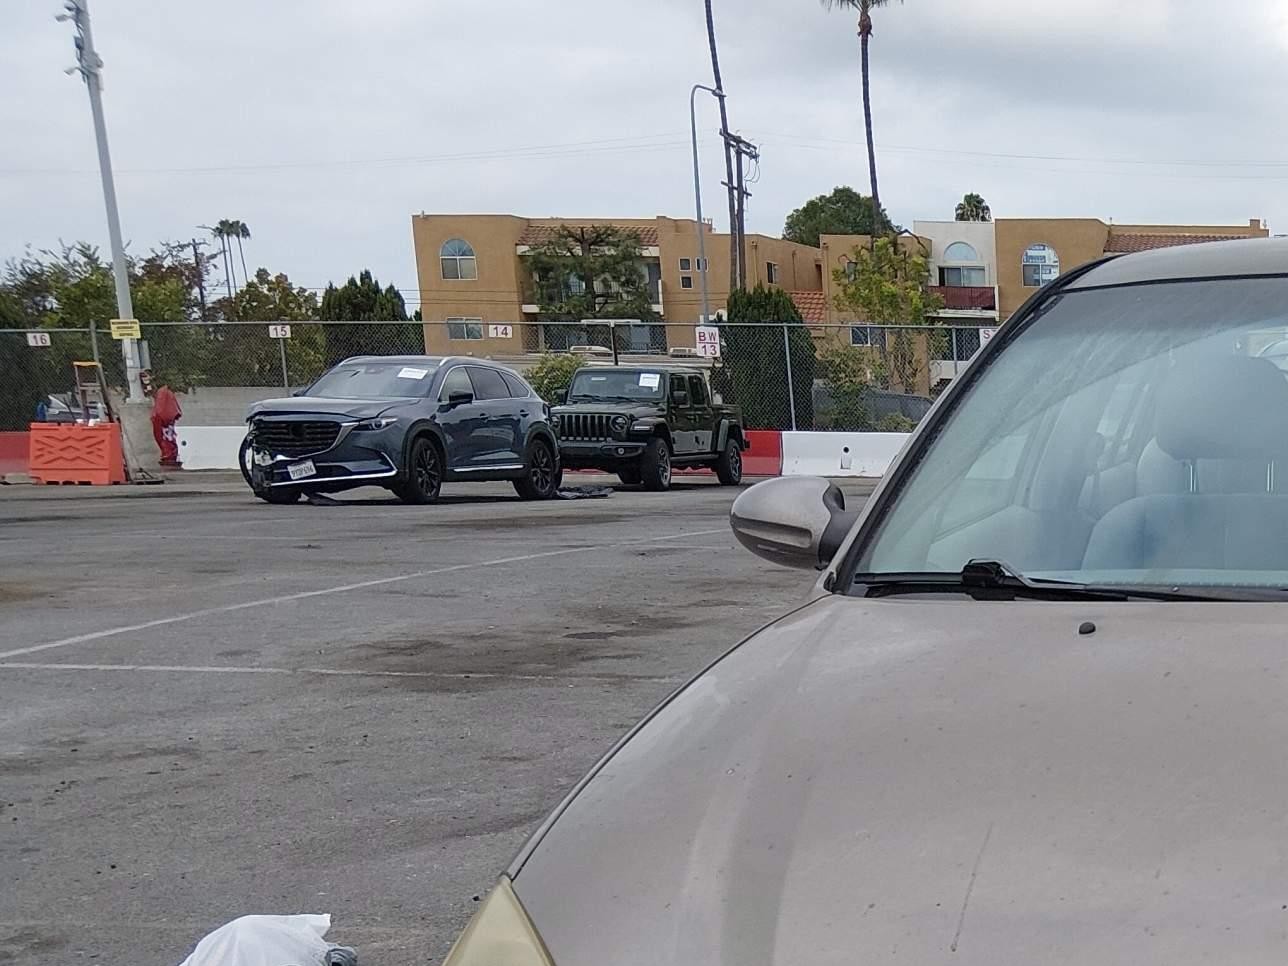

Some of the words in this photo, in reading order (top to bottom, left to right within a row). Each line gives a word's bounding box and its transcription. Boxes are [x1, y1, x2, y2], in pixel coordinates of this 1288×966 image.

[273, 326, 288, 337] 15
[493, 325, 509, 337] 14
[32, 334, 48, 345] 16
[701, 344, 718, 356] 13
